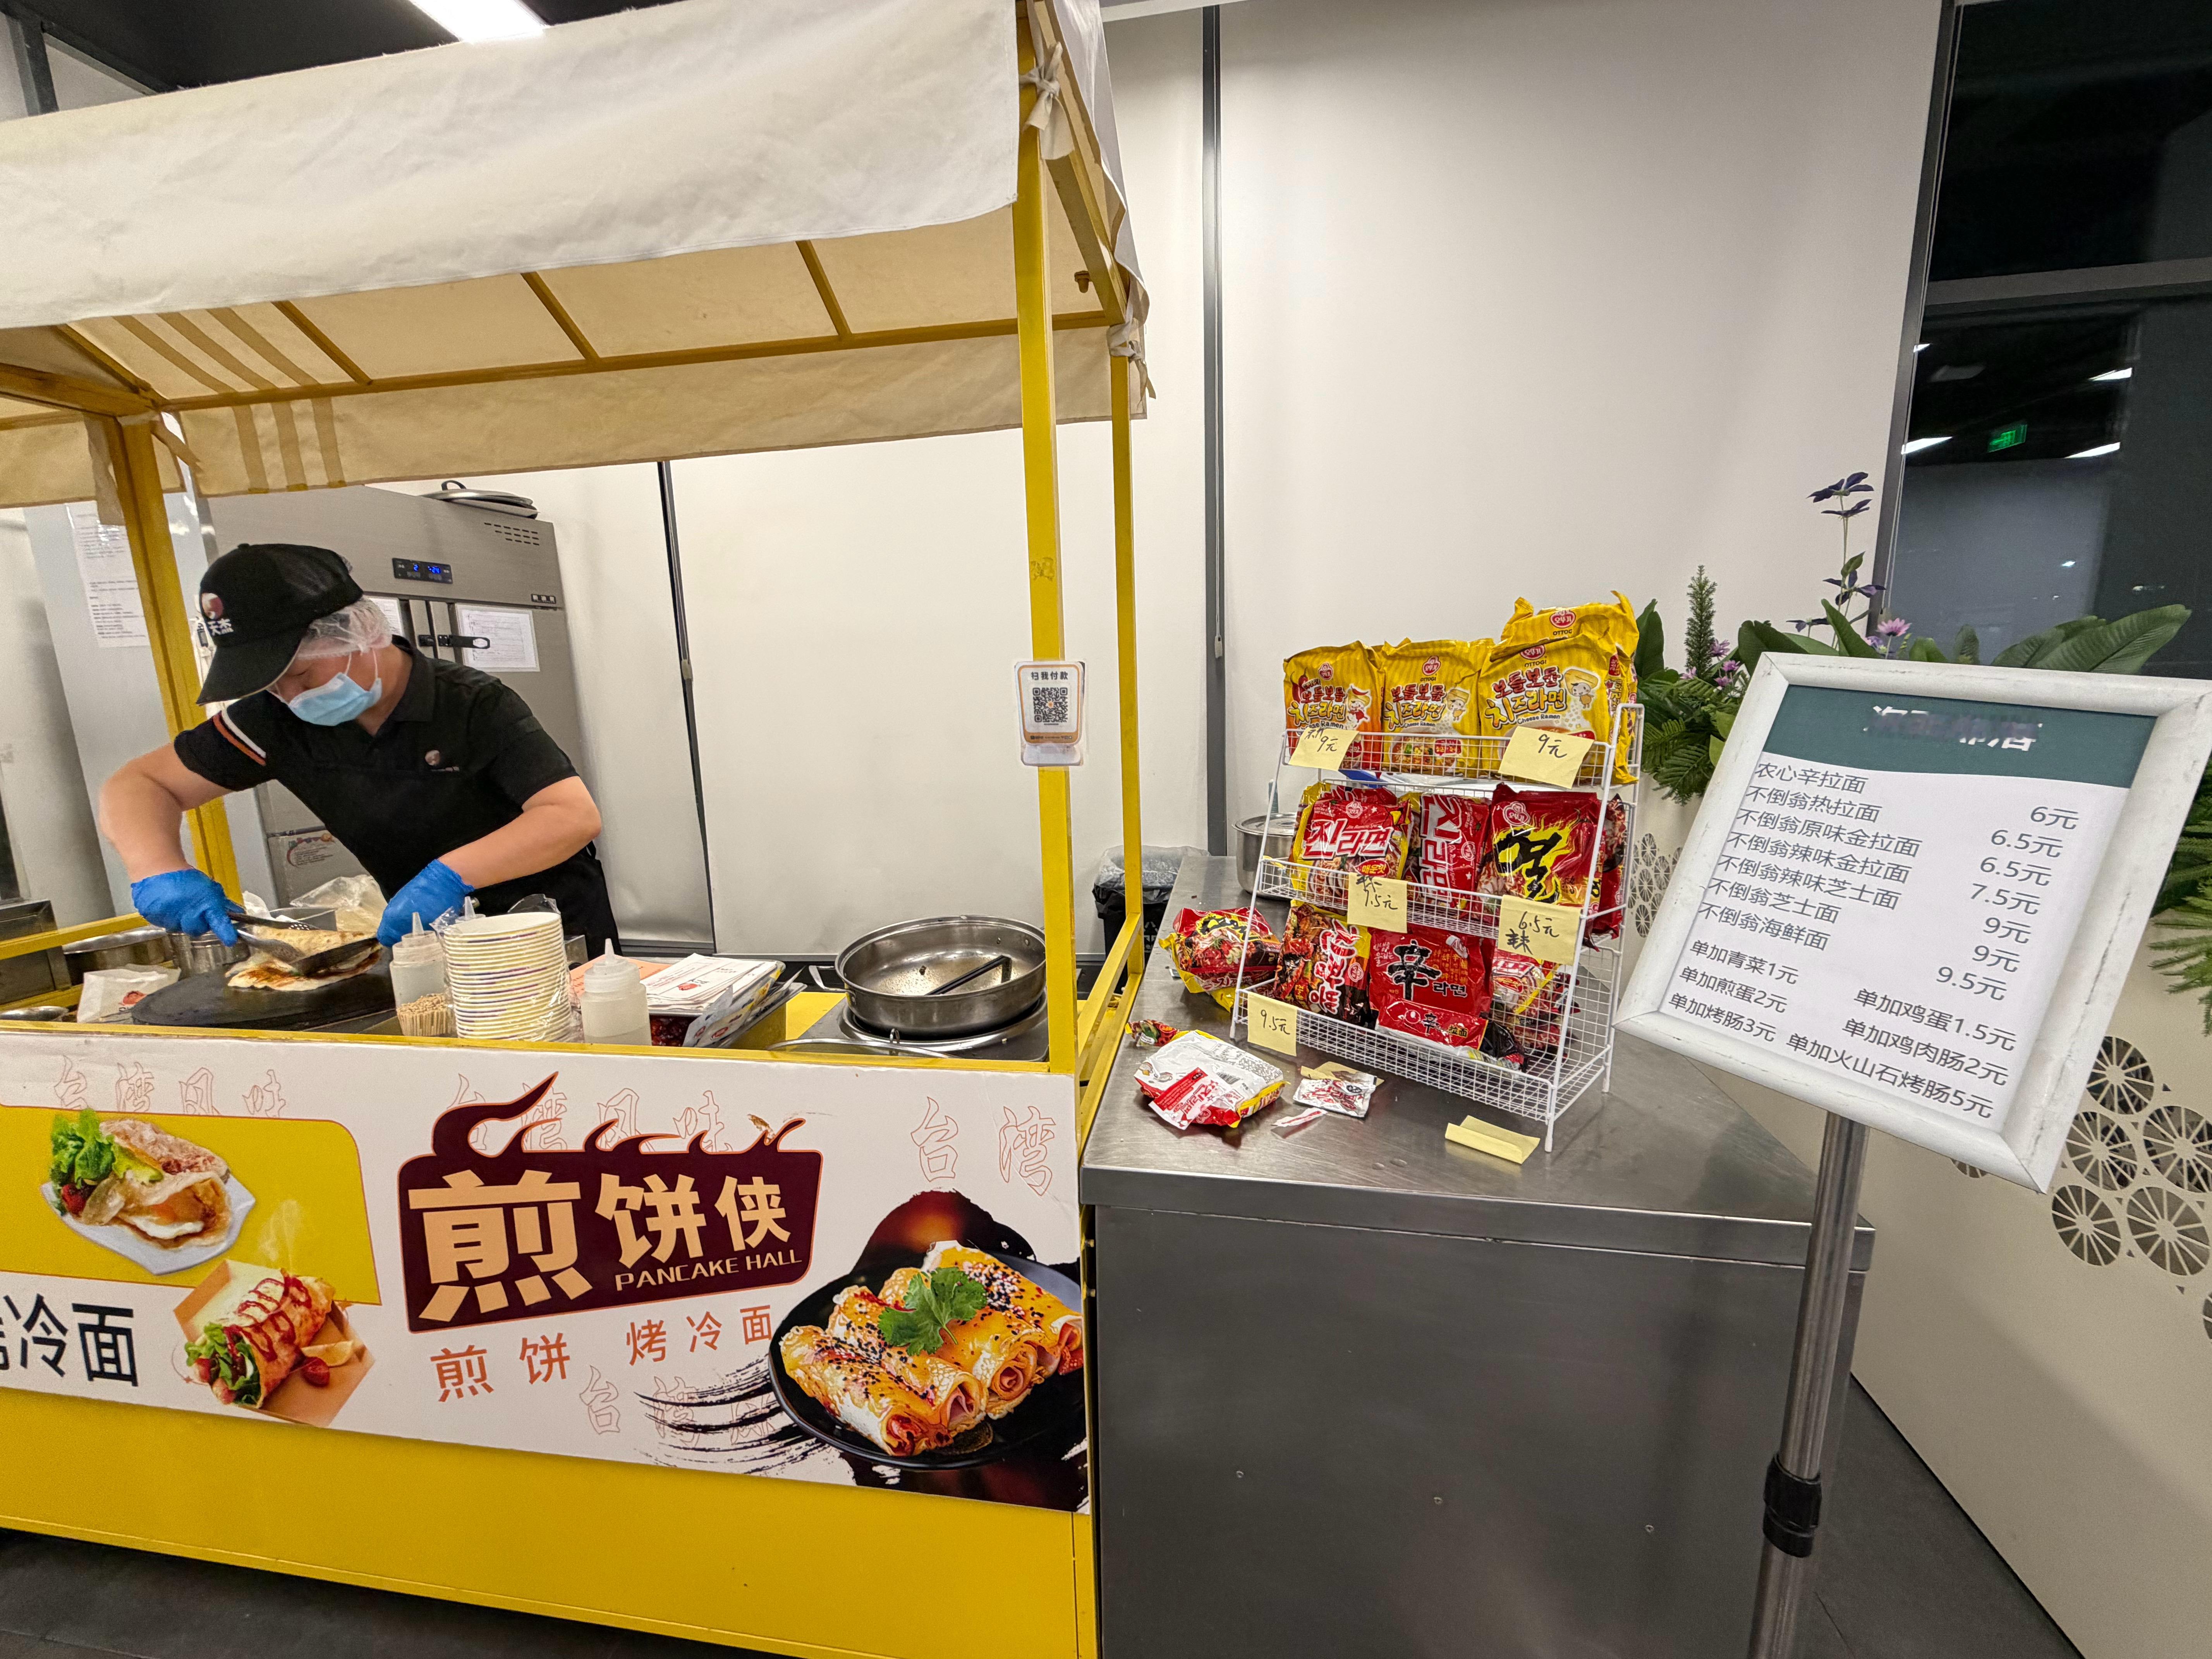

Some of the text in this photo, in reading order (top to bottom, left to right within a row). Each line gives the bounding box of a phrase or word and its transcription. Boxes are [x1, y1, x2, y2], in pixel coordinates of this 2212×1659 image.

[1031, 671, 1068, 680] 扫我付款
[1287, 701, 1346, 726] 치즈라면
[1321, 720, 1344, 729] Ramen
[1383, 700, 1445, 730] 치즈라면
[1484, 687, 1565, 728] 치즈라면
[1317, 736, 1338, 752] 9元
[1538, 733, 1568, 758] 9元
[1755, 762, 2079, 830] 农心辛拉面 6元
[1302, 818, 1394, 860] 진라면
[1746, 785, 2063, 858] 不倒翁热拉面 6.5元
[1362, 864, 1387, 874] 매운맛
[1736, 808, 2052, 886] 不倒翁原味金拉面 6.5元
[1727, 831, 2040, 915] 不倒翁辣味金拉面 7.5元
[1363, 889, 1398, 910] 7.5元
[1717, 854, 2031, 944] 不倒翁辣味芝士面 9元
[1518, 911, 1560, 938] 6.5元
[1708, 878, 2020, 972] 不倒翁芝士面 9元
[1386, 939, 1443, 1001] 辛
[1690, 940, 1799, 985] 单加青菜1元
[1698, 902, 2007, 1001] 不倒翁海鲜面 9.5元
[1432, 981, 1468, 998] 라면
[1679, 966, 2016, 1052] 单加煎蛋2元 单加鸡蛋1.5元
[1261, 1009, 1291, 1035] 9.5元
[1669, 993, 2009, 1086] 单加烤肠3元 单加鸡肉肠2元
[1786, 1033, 1994, 1119] 单加火山石烤肠5元
[911, 1097, 1056, 1196] 台湾
[408, 1169, 791, 1322] 煎饼侠
[615, 1249, 802, 1291] PANCAKE HALL
[430, 1304, 773, 1403] 煎饼 烤冷面
